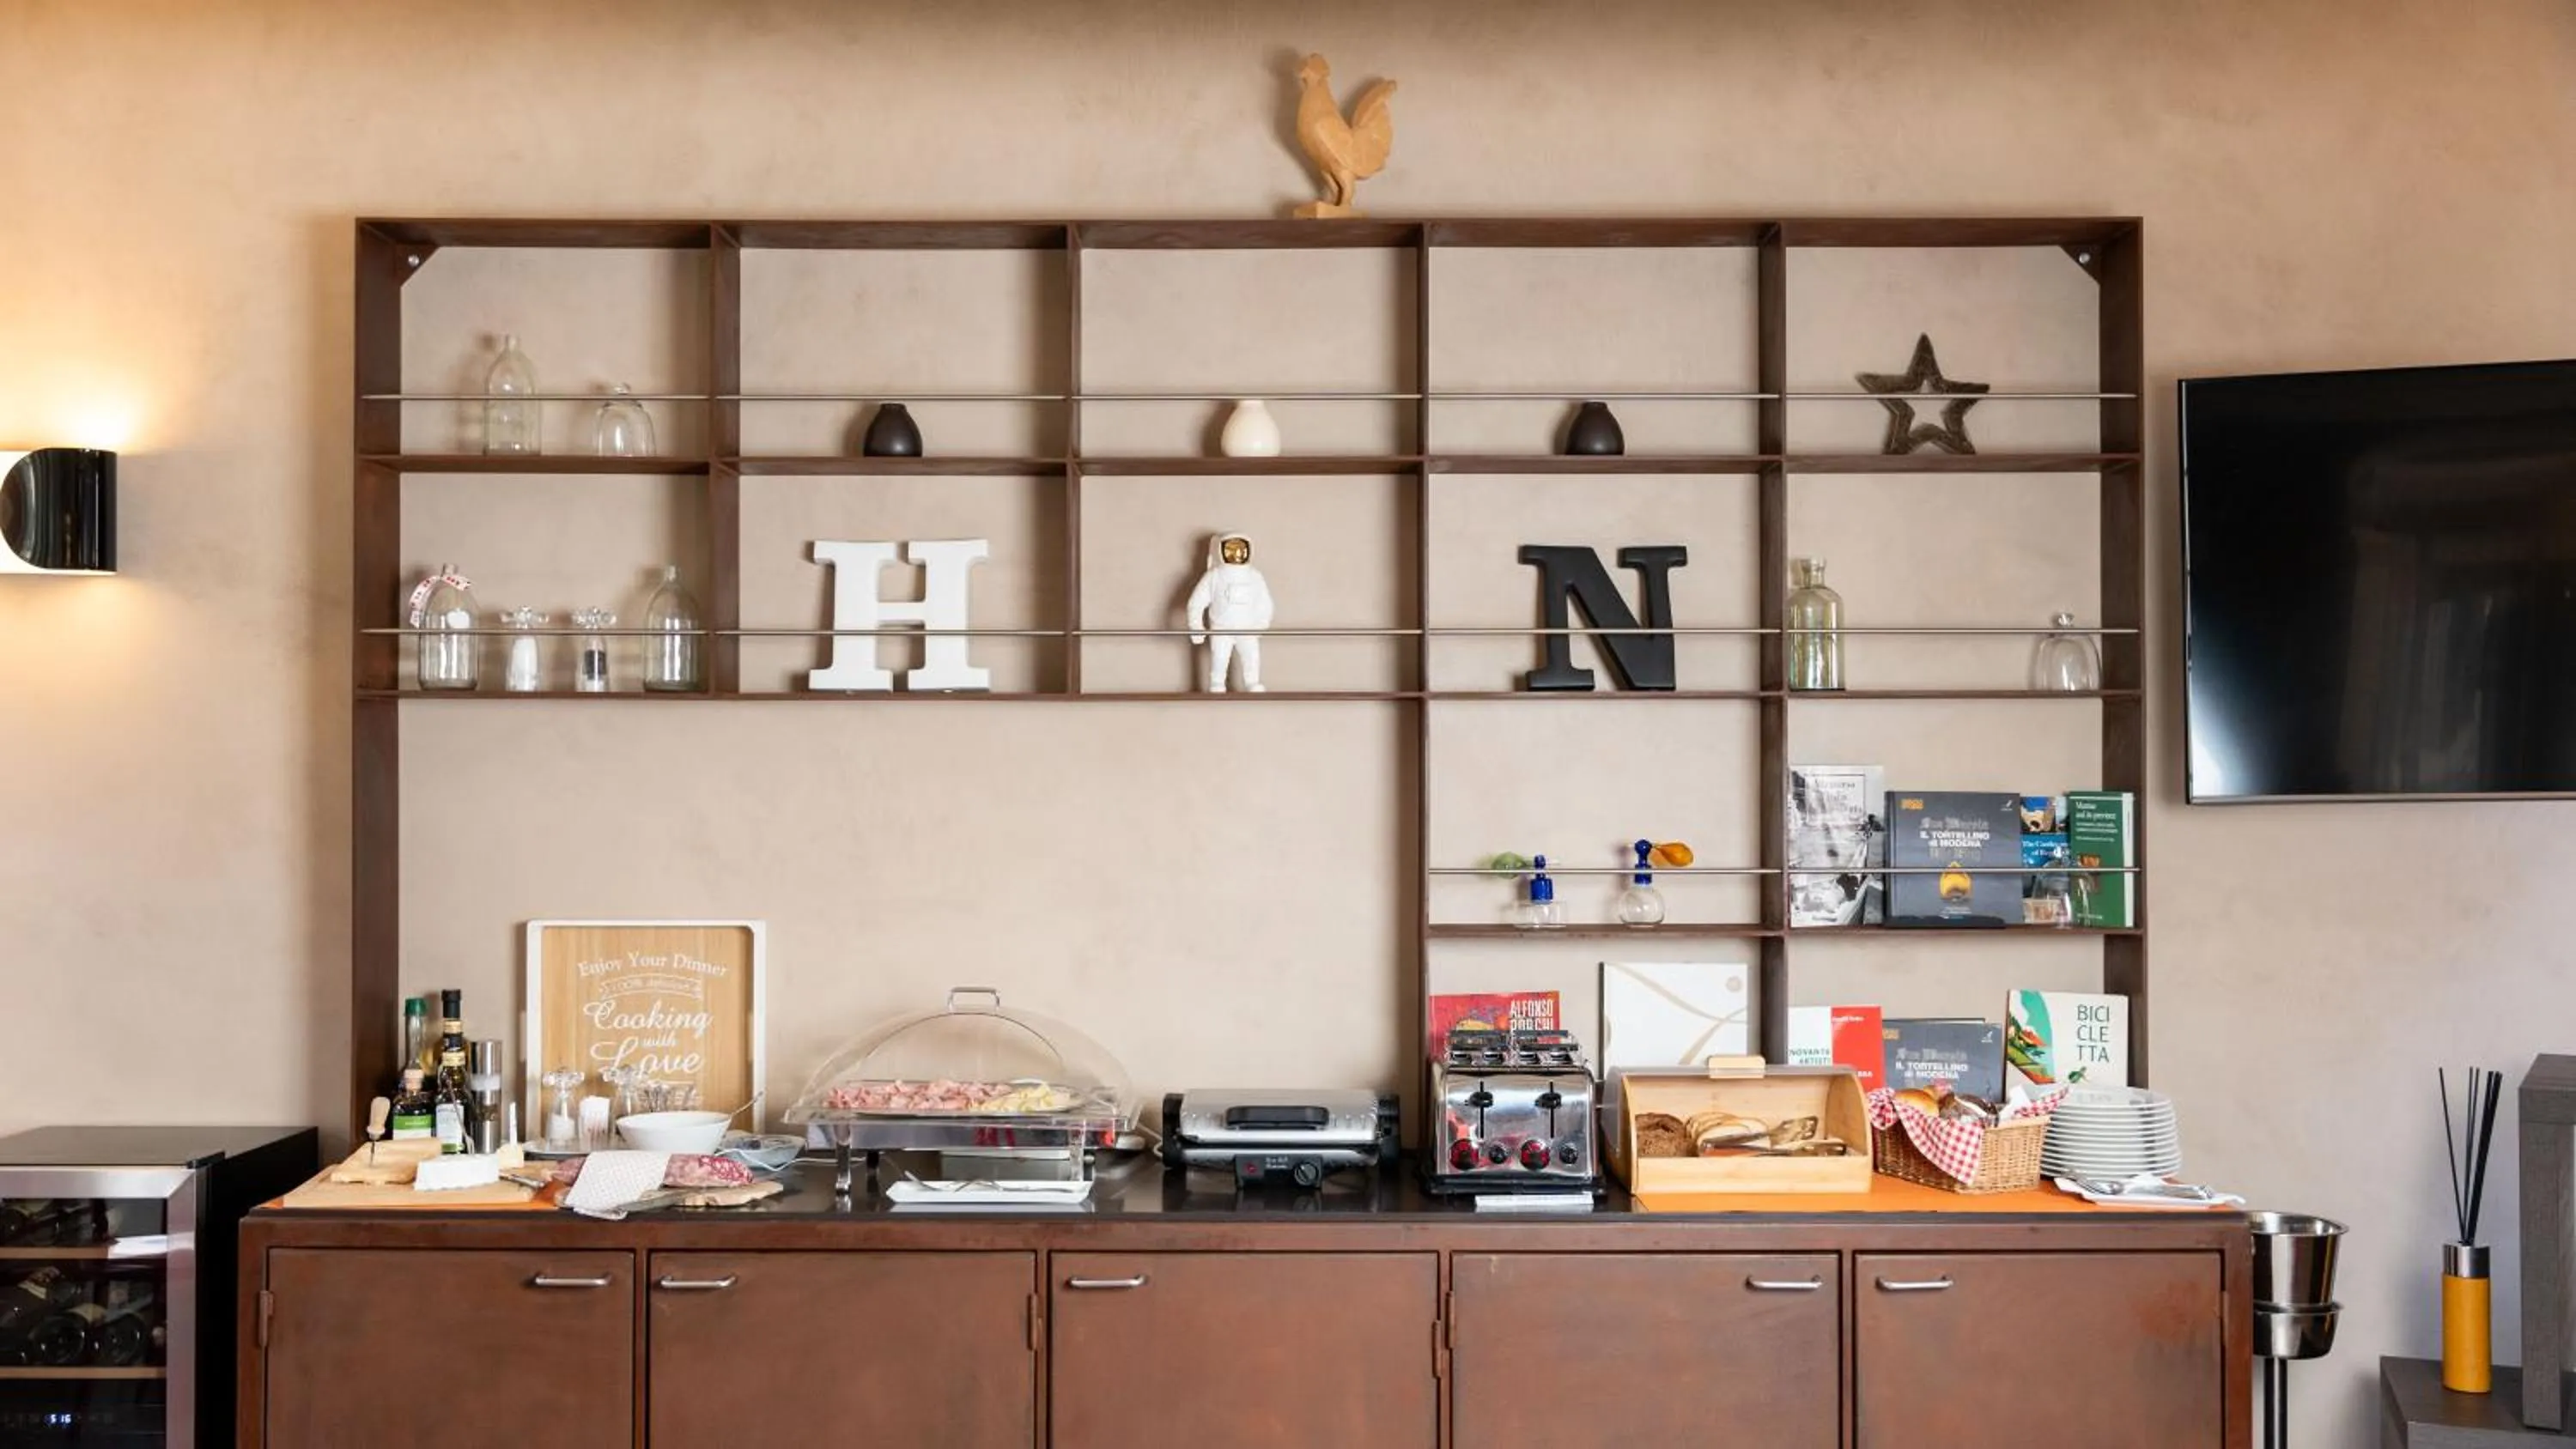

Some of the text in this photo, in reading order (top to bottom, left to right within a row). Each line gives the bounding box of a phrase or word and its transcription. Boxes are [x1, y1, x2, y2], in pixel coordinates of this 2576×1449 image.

[809, 539, 990, 690] H
[1517, 545, 1687, 691] N
[1931, 830, 1990, 840] TORTELLINO
[1940, 839, 1982, 848] MODENA
[577, 950, 730, 978] Enjoy Your Dinner
[1511, 998, 1553, 1018] ALFONSO
[2076, 1004, 2110, 1022] BICI
[583, 999, 714, 1039] Cooking
[641, 1029, 677, 1048] with
[2076, 1024, 2110, 1043] CLE
[591, 1036, 704, 1078] Love
[2076, 1045, 2110, 1063] TTA
[1906, 1061, 1969, 1072] TORTELLINO
